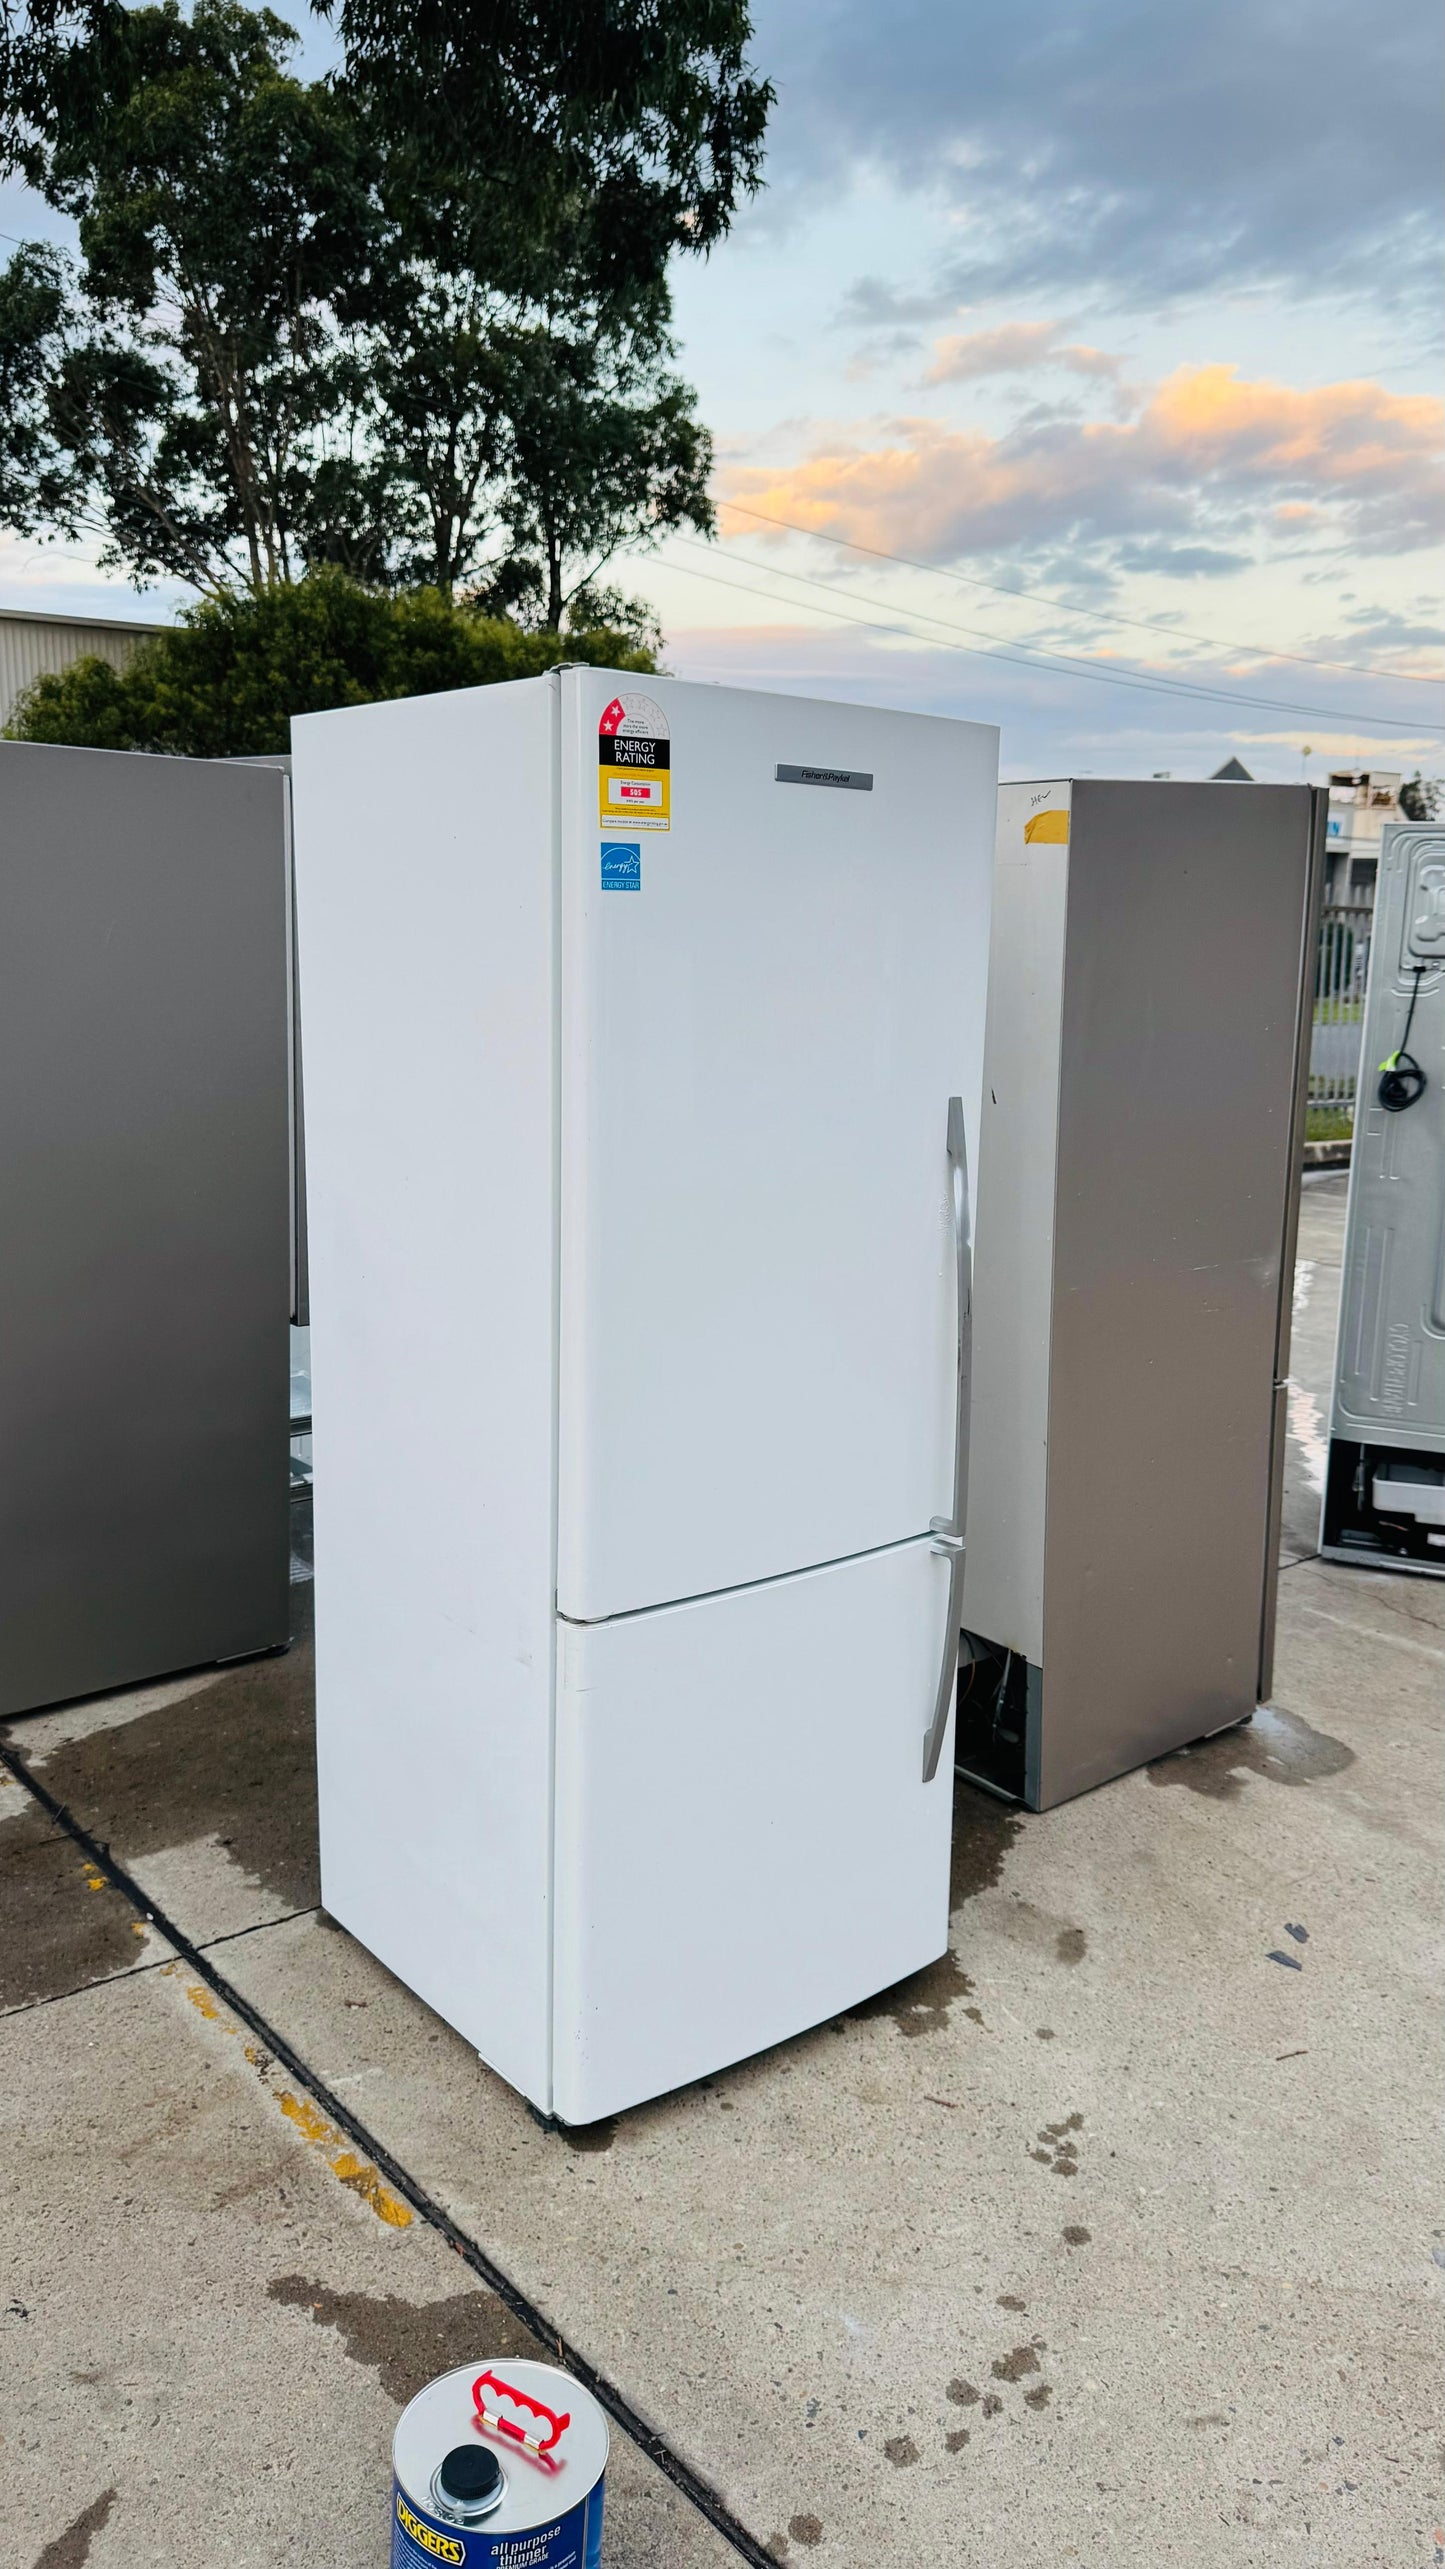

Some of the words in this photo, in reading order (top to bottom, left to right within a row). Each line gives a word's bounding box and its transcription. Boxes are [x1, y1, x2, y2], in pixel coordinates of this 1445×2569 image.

[614, 739, 656, 753] ENERGY
[615, 752, 656, 765] RATING
[603, 881, 625, 889] ENERGY
[625, 881, 640, 889] STAR
[398, 2497, 460, 2562] DIGGERS
[490, 2542, 509, 2556] all
[511, 2525, 561, 2554] purpose
[499, 2545, 547, 2566] thinner
[528, 2552, 549, 2566] GRADE
